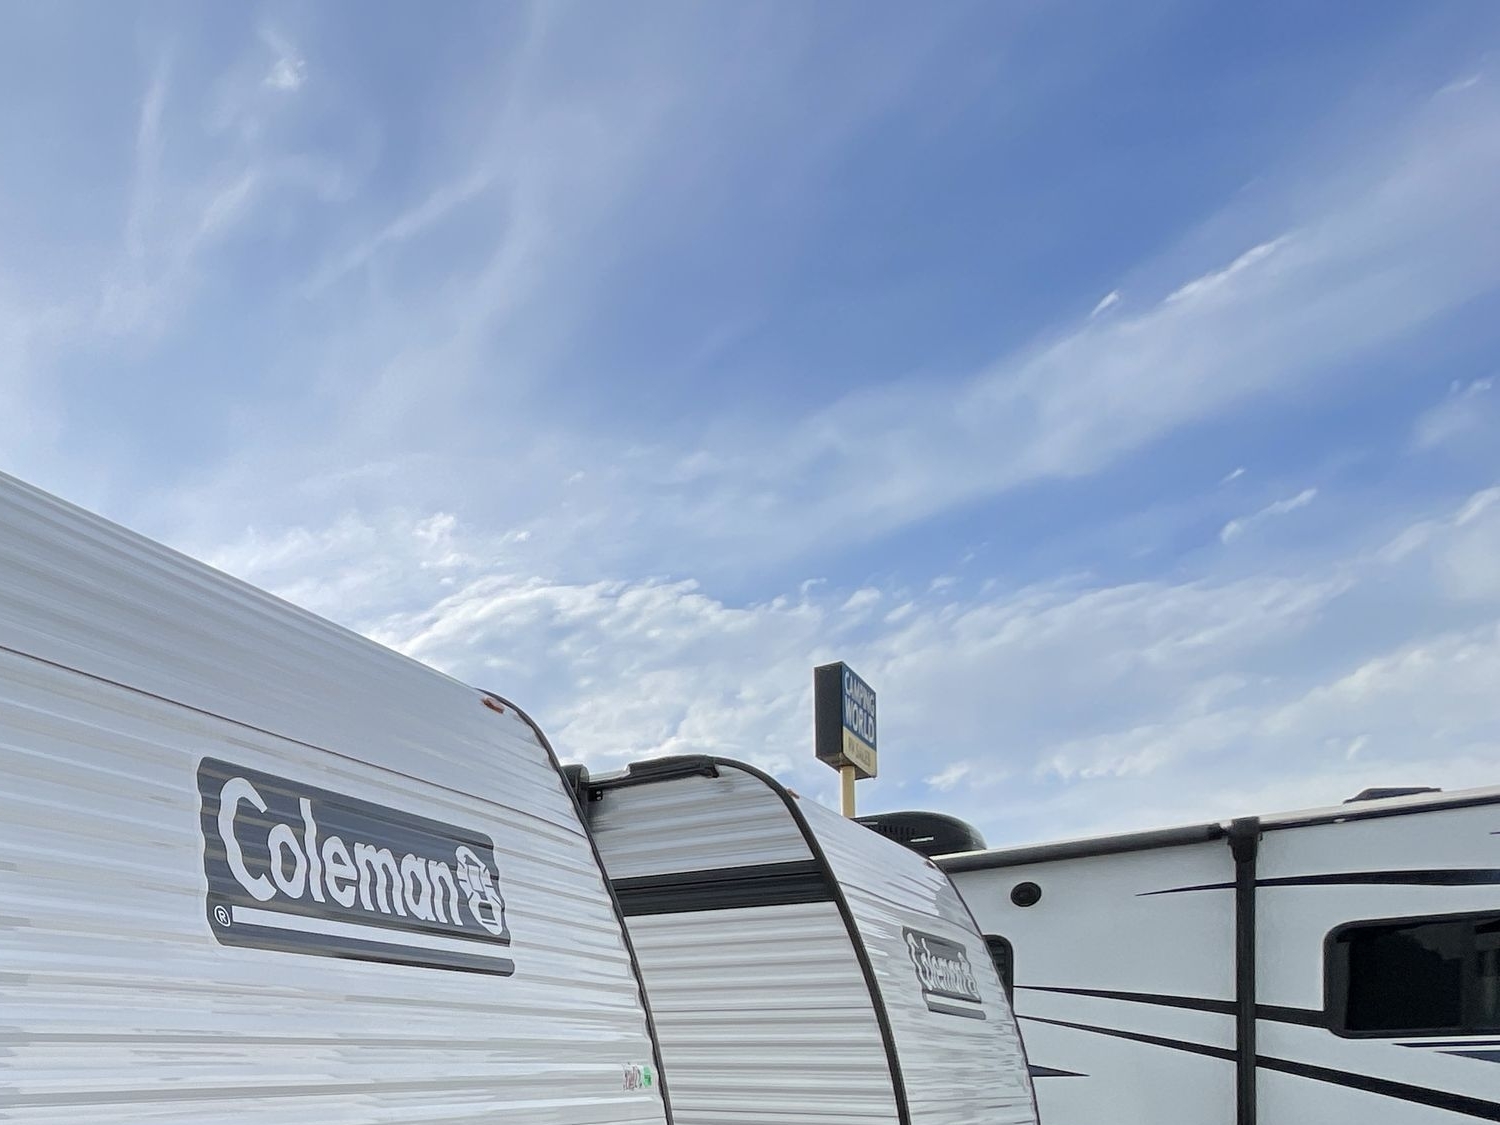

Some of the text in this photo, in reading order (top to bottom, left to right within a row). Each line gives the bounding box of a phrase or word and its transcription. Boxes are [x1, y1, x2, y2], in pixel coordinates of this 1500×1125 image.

[845, 671, 875, 717] CAMPING
[845, 694, 875, 743] WORLD
[218, 777, 463, 926] Coleman
